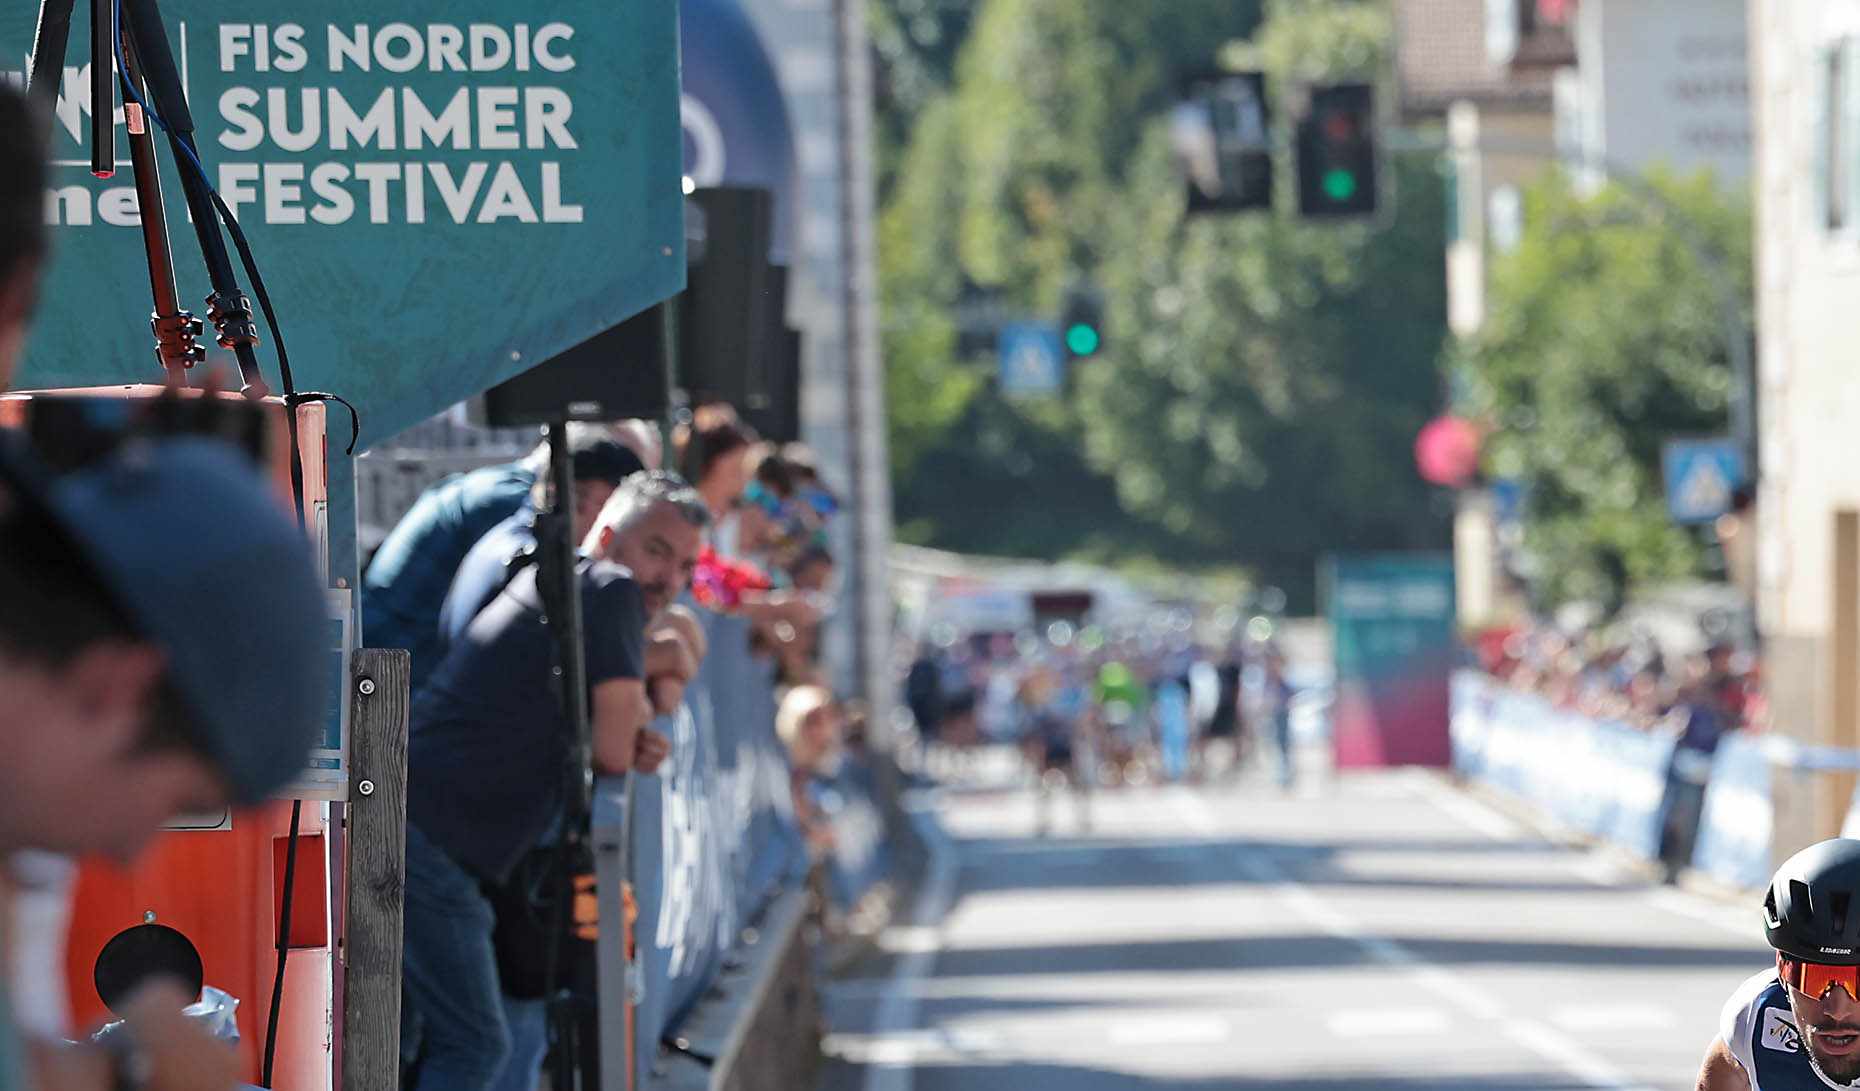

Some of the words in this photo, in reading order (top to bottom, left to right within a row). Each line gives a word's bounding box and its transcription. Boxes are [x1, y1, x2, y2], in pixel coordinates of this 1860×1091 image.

[218, 23, 306, 72] FIS
[327, 23, 577, 73] NORDIC
[217, 86, 578, 152] SUMMER
[217, 162, 583, 225] FESTIVAL
